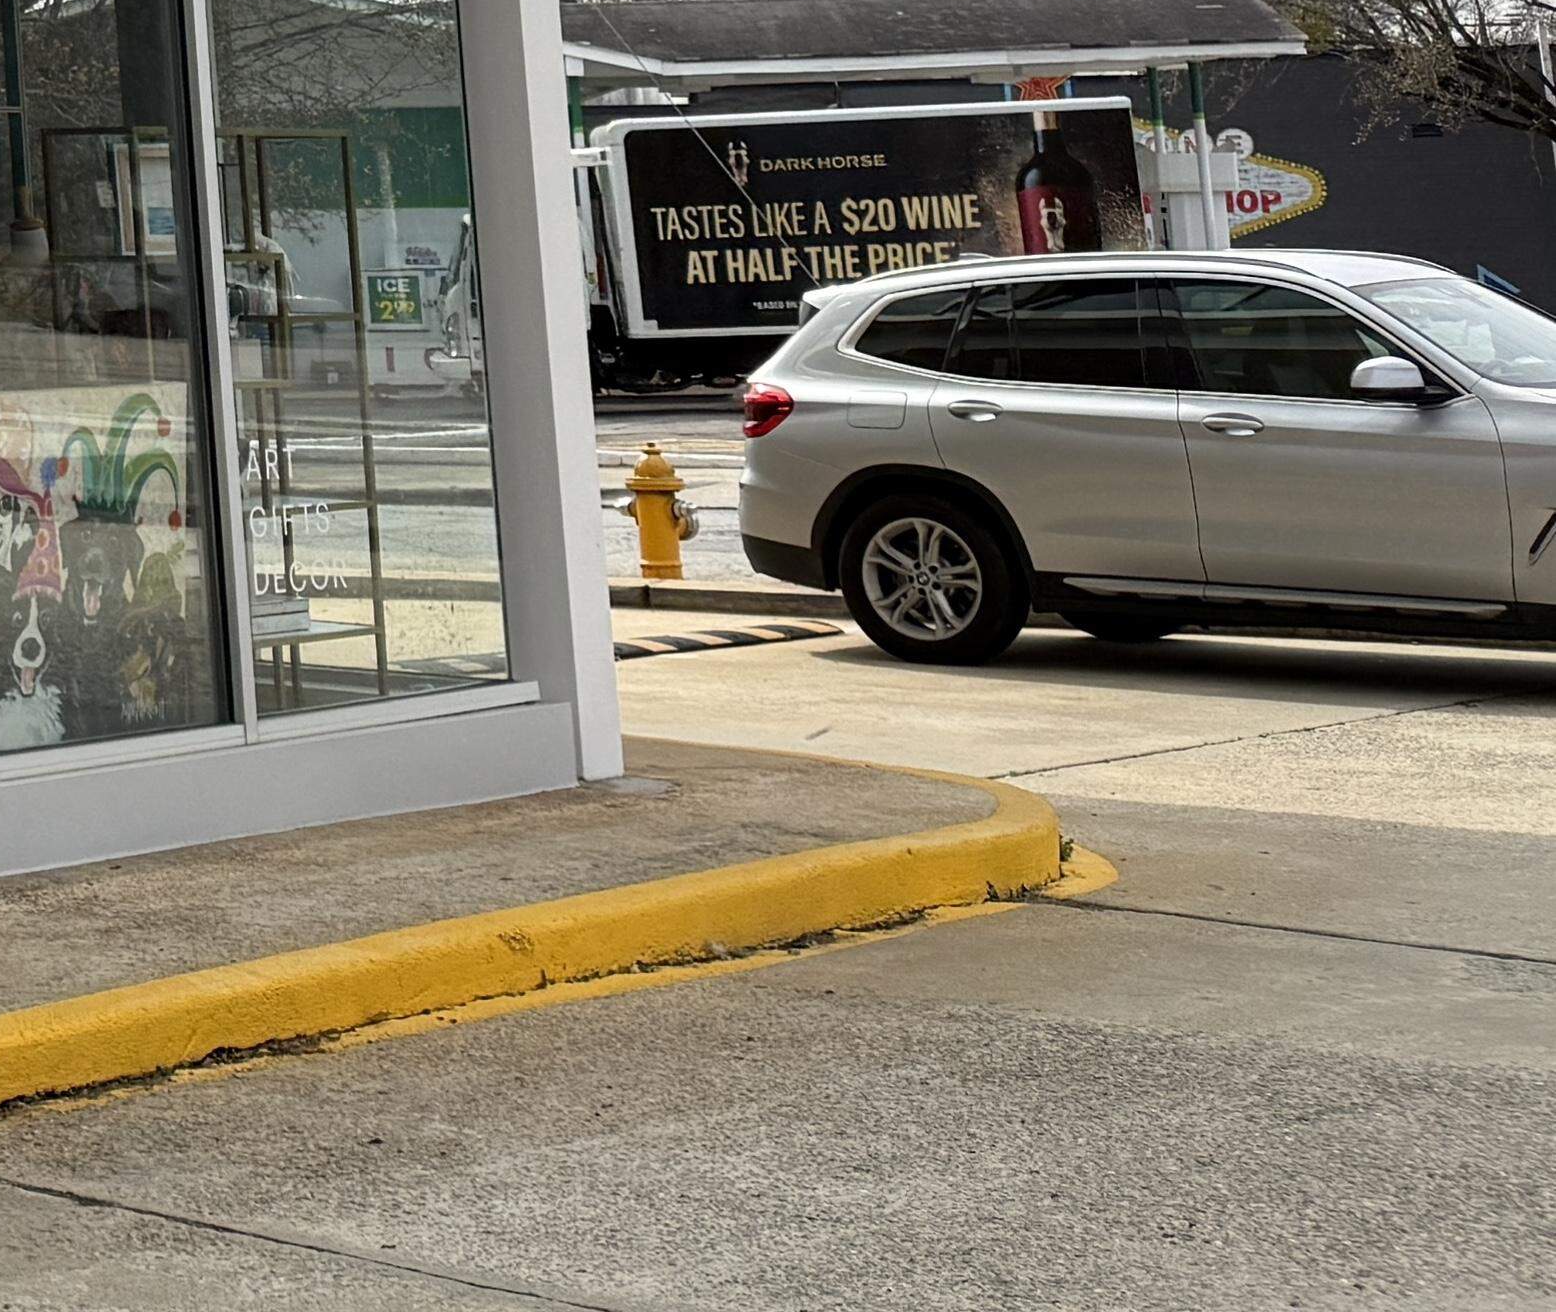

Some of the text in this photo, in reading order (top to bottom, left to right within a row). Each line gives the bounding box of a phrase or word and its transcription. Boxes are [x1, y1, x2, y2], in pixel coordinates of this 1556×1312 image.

[759, 153, 888, 173] DARK HORSE
[650, 193, 982, 242] TASTES LIKE A $20 WINE
[686, 250, 719, 285] AT
[725, 246, 798, 284] HALF
[803, 244, 863, 280] THE
[376, 278, 411, 293] ICE
[246, 446, 297, 481] ART
[249, 502, 330, 538] GIFTS
[254, 559, 348, 596] DECOR
